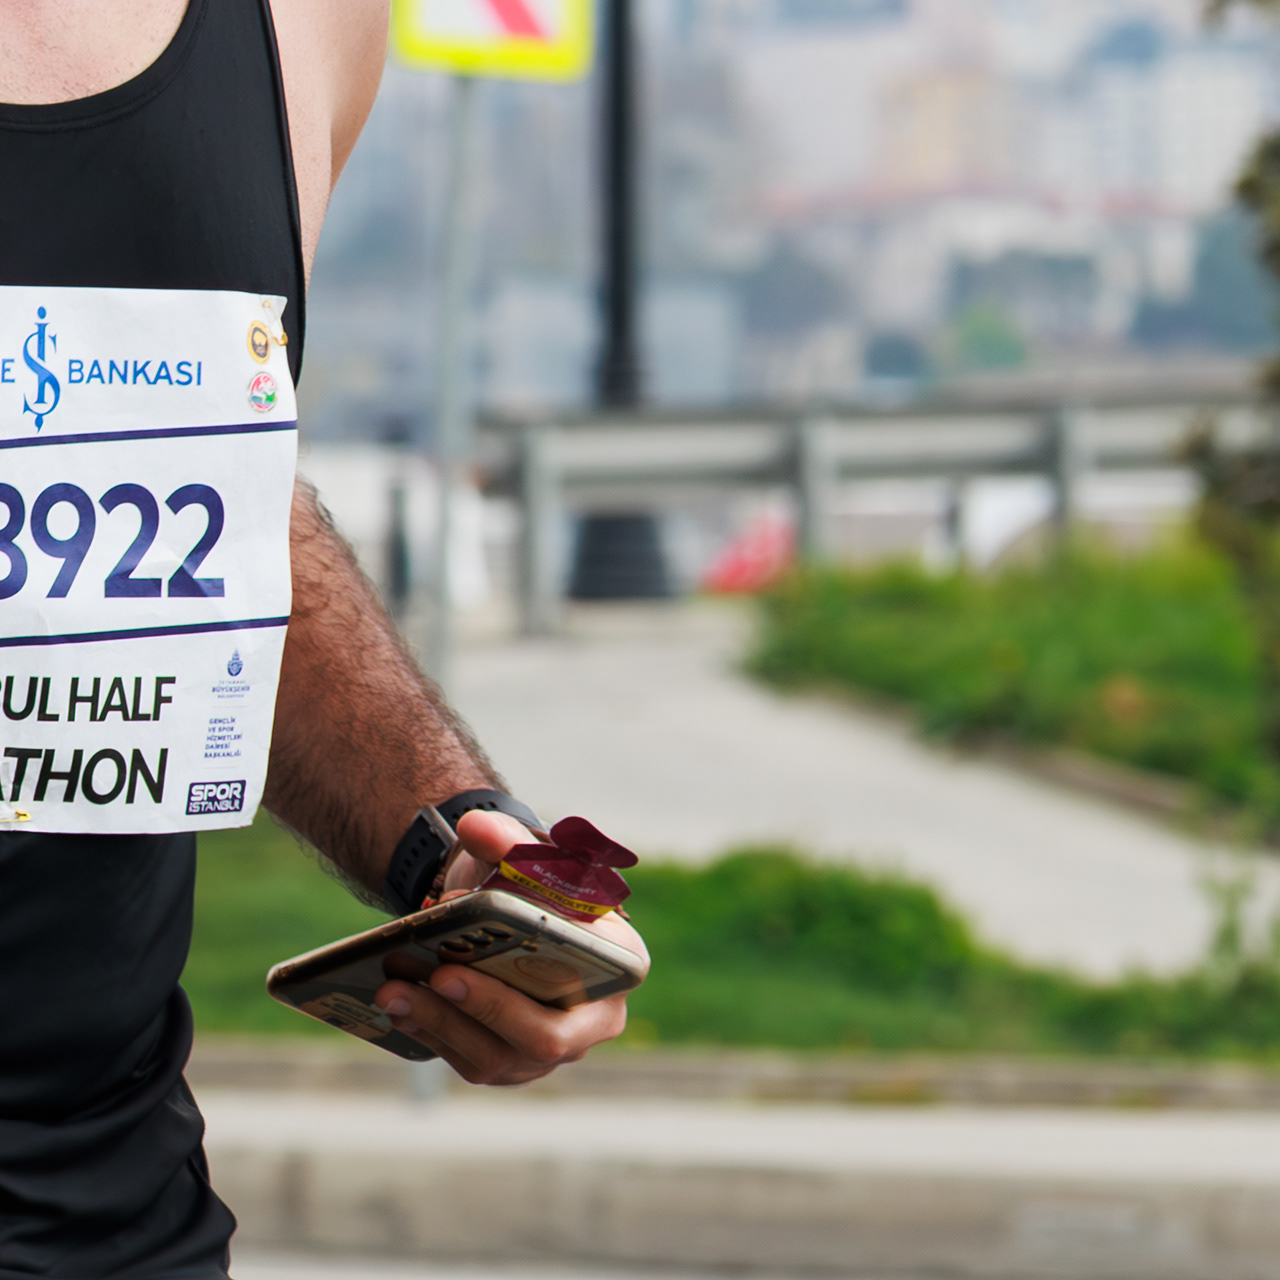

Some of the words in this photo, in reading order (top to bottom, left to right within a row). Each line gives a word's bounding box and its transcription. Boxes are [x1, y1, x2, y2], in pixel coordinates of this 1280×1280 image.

[67, 359, 202, 387] BANKASI
[67, 676, 177, 722] HALF
[190, 782, 242, 801] SPOR
